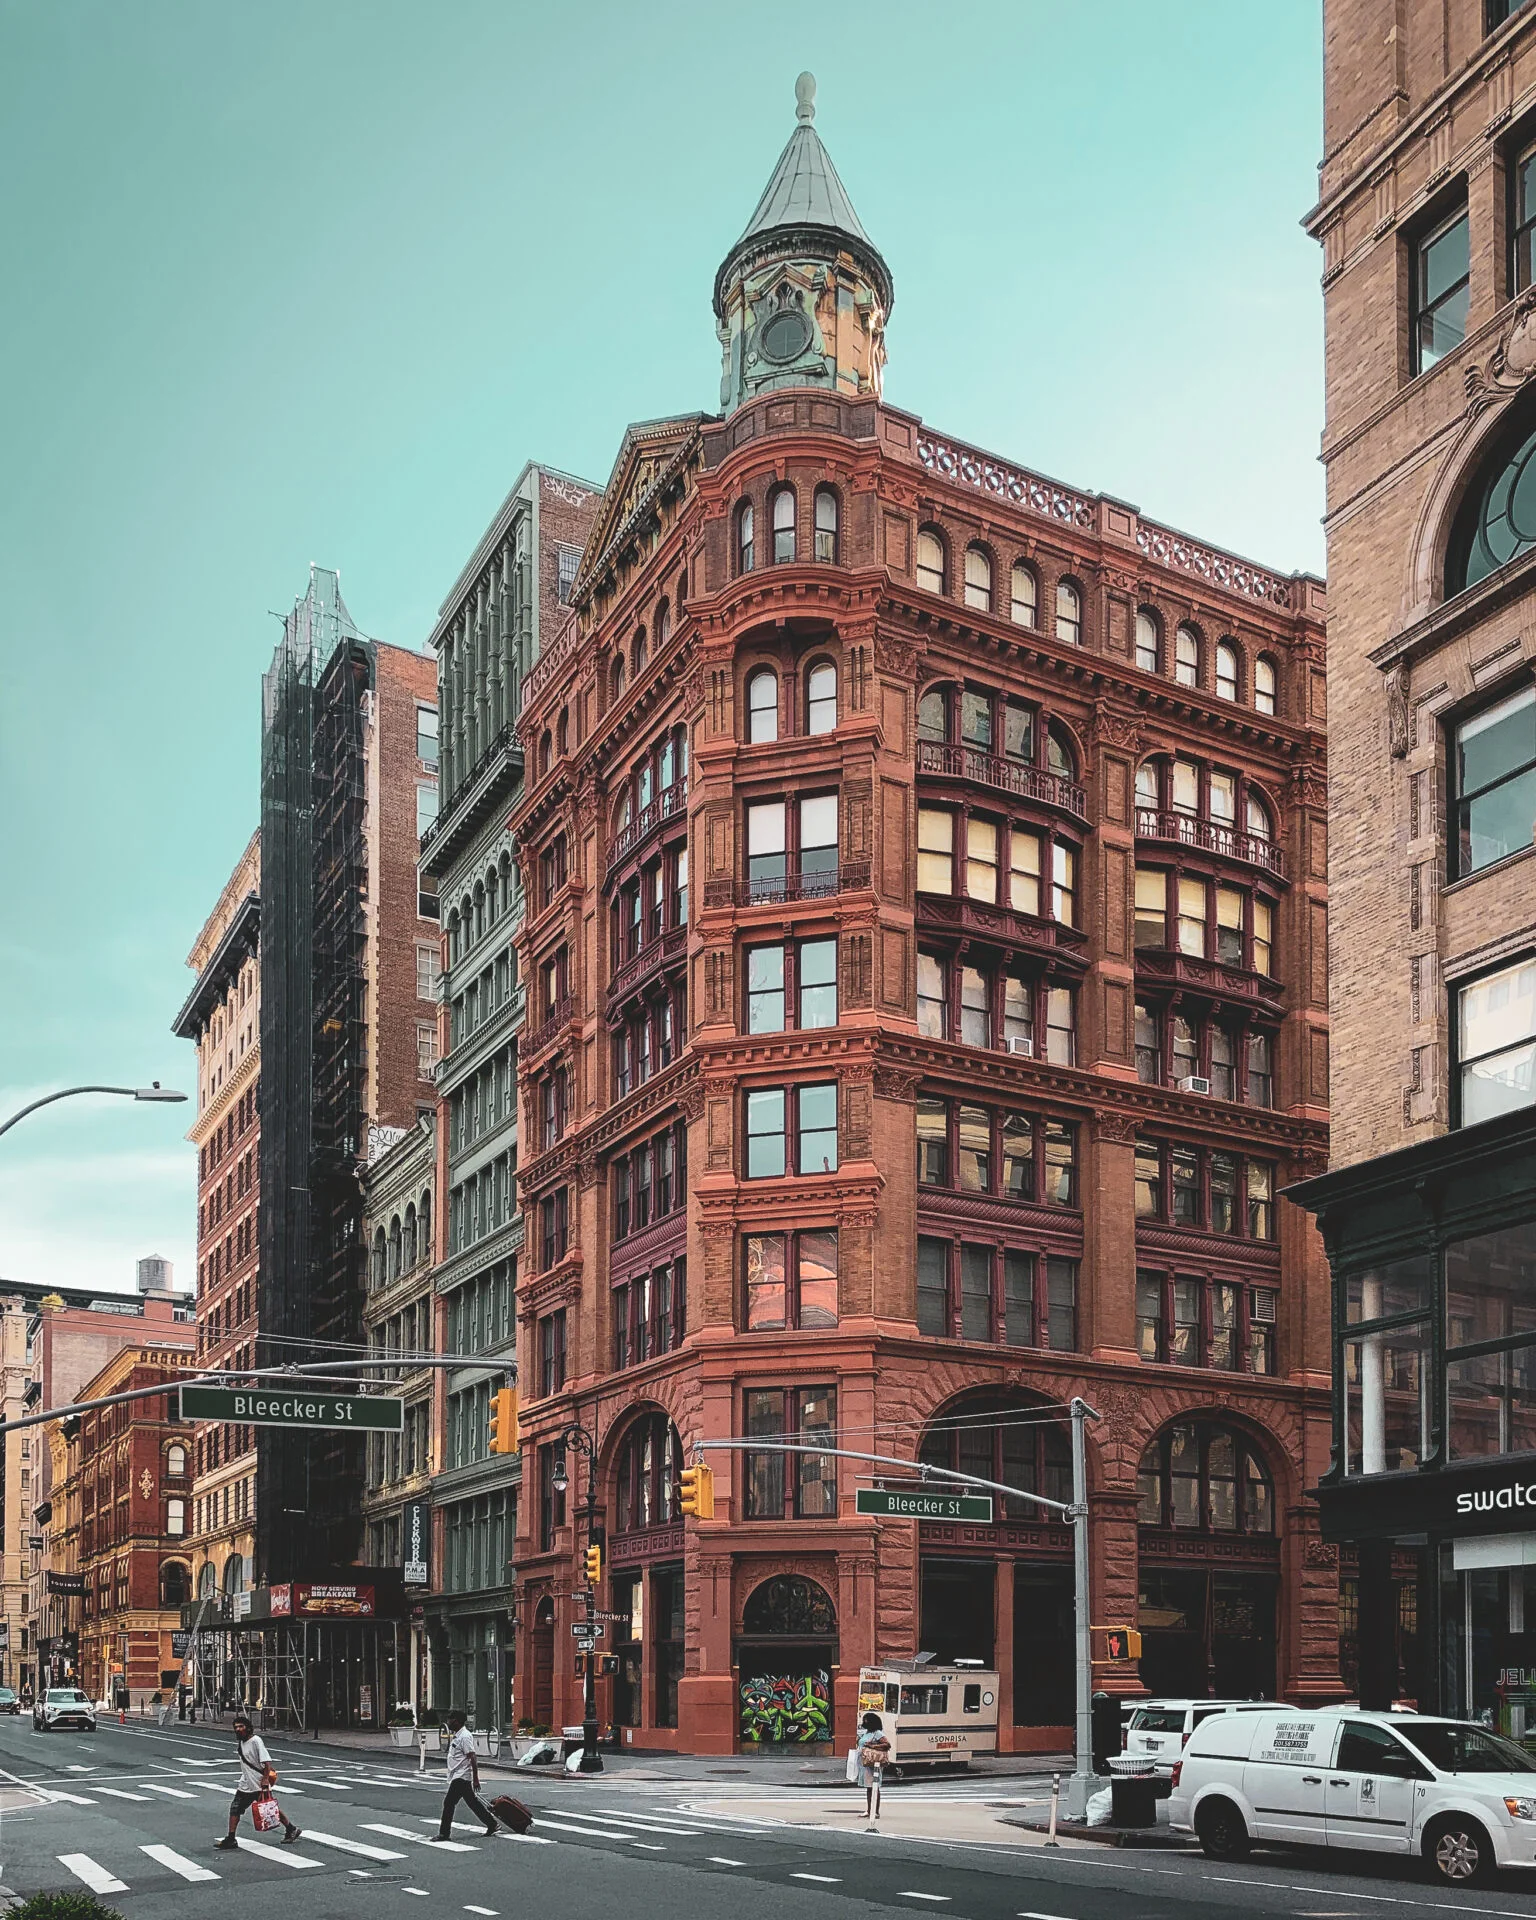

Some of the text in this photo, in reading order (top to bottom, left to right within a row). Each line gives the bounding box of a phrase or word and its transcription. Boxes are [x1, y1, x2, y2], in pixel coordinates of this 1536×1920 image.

[234, 1396, 353, 1420] Bleecker St
[888, 1496, 961, 1515] Bleecker St
[1456, 1482, 1536, 1513] swatc
[411, 1506, 421, 1564] CLOCKWORK
[595, 1611, 620, 1621] Bleecker
[934, 1735, 967, 1743] SONRISA
[1417, 1787, 1426, 1797] 70
